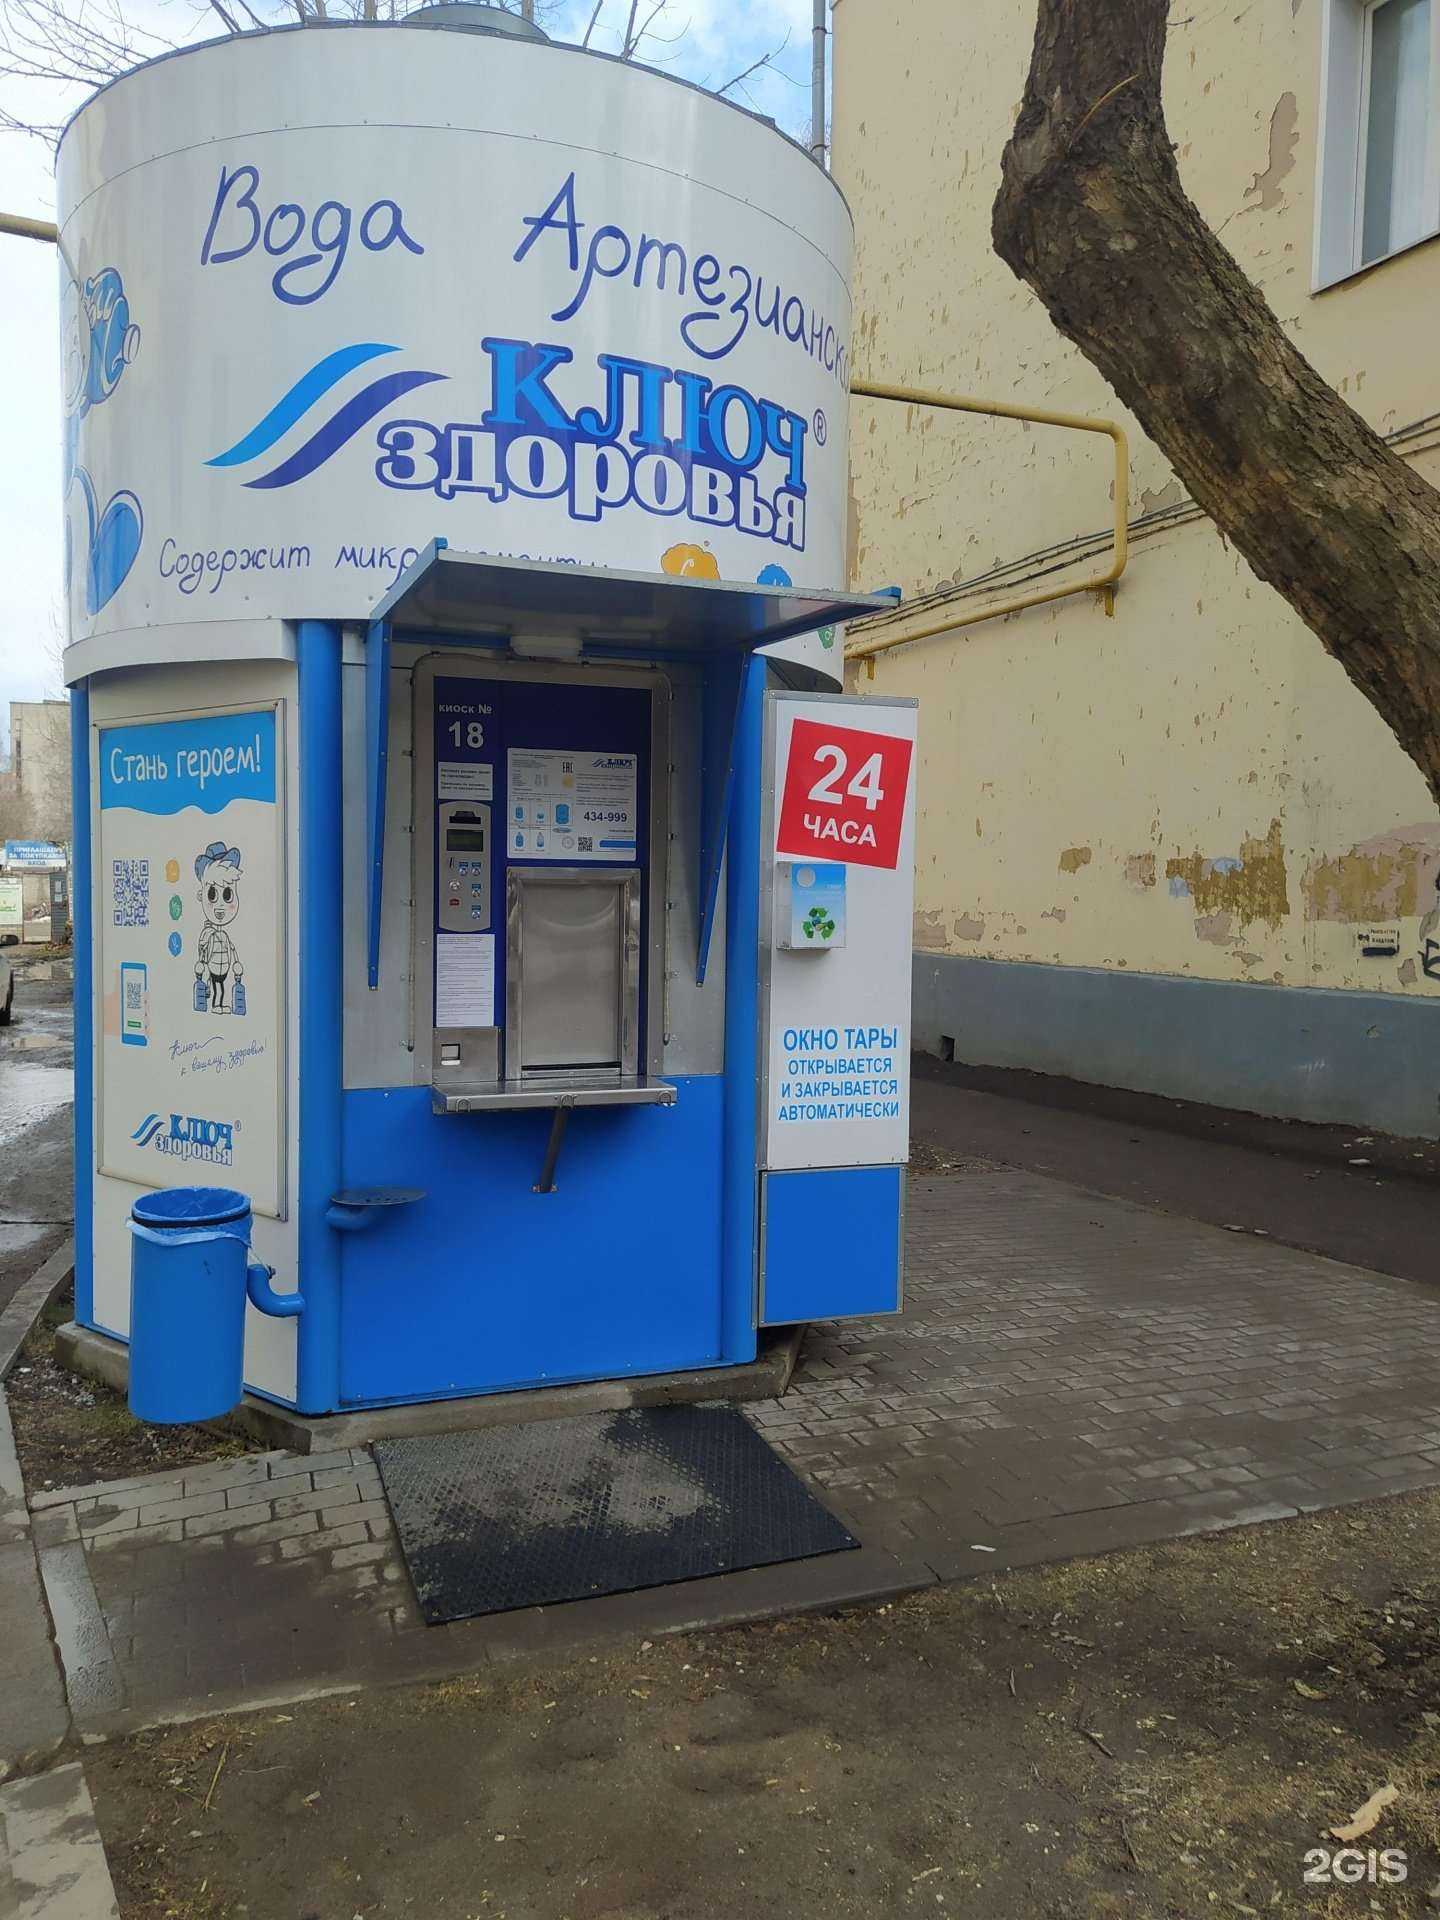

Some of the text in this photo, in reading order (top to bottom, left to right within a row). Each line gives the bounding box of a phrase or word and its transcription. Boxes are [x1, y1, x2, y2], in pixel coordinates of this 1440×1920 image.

[200, 165, 424, 305] Вода
[481, 337, 808, 492] КЛЮЧ
[375, 420, 806, 552] здоровья
[159, 538, 310, 594] Содержит
[448, 720, 484, 749] 18
[110, 734, 261, 790] Стань героем!
[808, 744, 884, 811] 24
[583, 811, 628, 823] 434-999
[803, 813, 877, 848] ЧАСА
[783, 1028, 897, 1051] ОКНО ТАРЫ
[788, 1057, 892, 1076] ОТКРЫВАЕТСЯ
[781, 1080, 898, 1098] И ЗАКРЫВАЕТСЯ
[778, 1102, 899, 1121] АВТОМАТИЧЕСКИ
